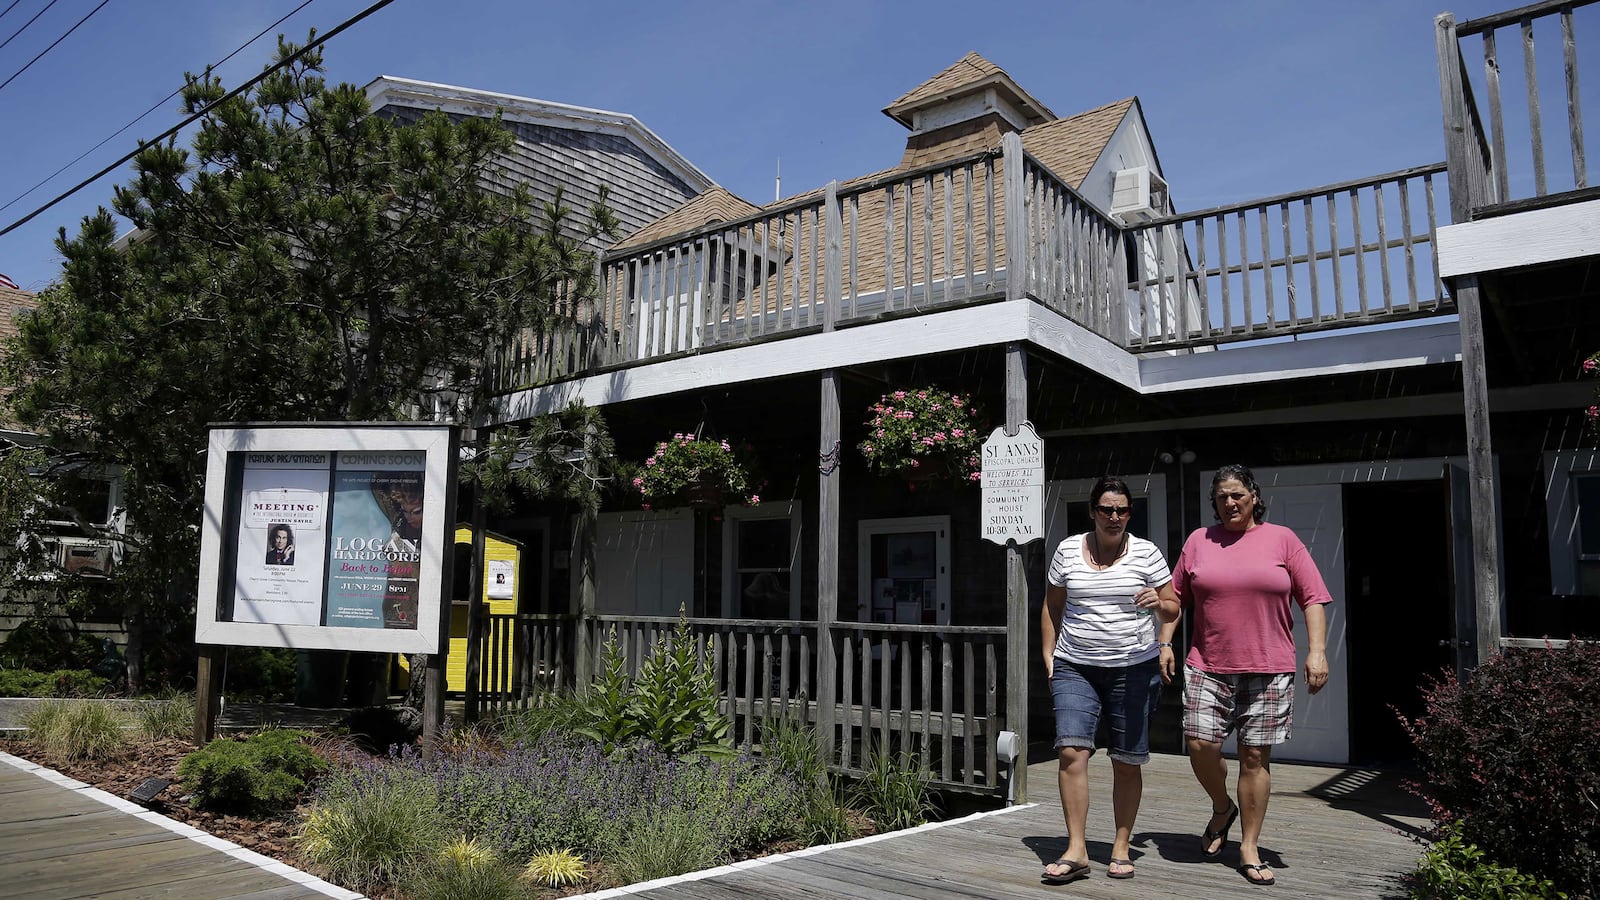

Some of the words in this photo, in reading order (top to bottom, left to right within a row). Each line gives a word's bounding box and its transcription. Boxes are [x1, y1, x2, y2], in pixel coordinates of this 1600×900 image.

[986, 445, 999, 459] ST
[1004, 442, 1039, 457] ANNS
[341, 454, 386, 465] COMING
[388, 454, 422, 465] SOON
[984, 458, 1015, 467] EPISCOPAL
[1017, 456, 1040, 465] CHURCH
[986, 470, 1019, 478] WELCOMES
[1022, 469, 1033, 477] ALL
[998, 479, 1030, 487] SERVICES
[986, 496, 1030, 504] COMMUNITY
[990, 515, 1024, 525] SUNDAY
[986, 525, 1008, 535] 10:30
[335, 536, 418, 553] LOGAN
[334, 550, 420, 562] HARDCORE
[340, 562, 368, 574] Back
[370, 565, 379, 573] to
[340, 583, 370, 591] JUNE
[371, 583, 383, 592] 29
[388, 584, 407, 593] 8PM
